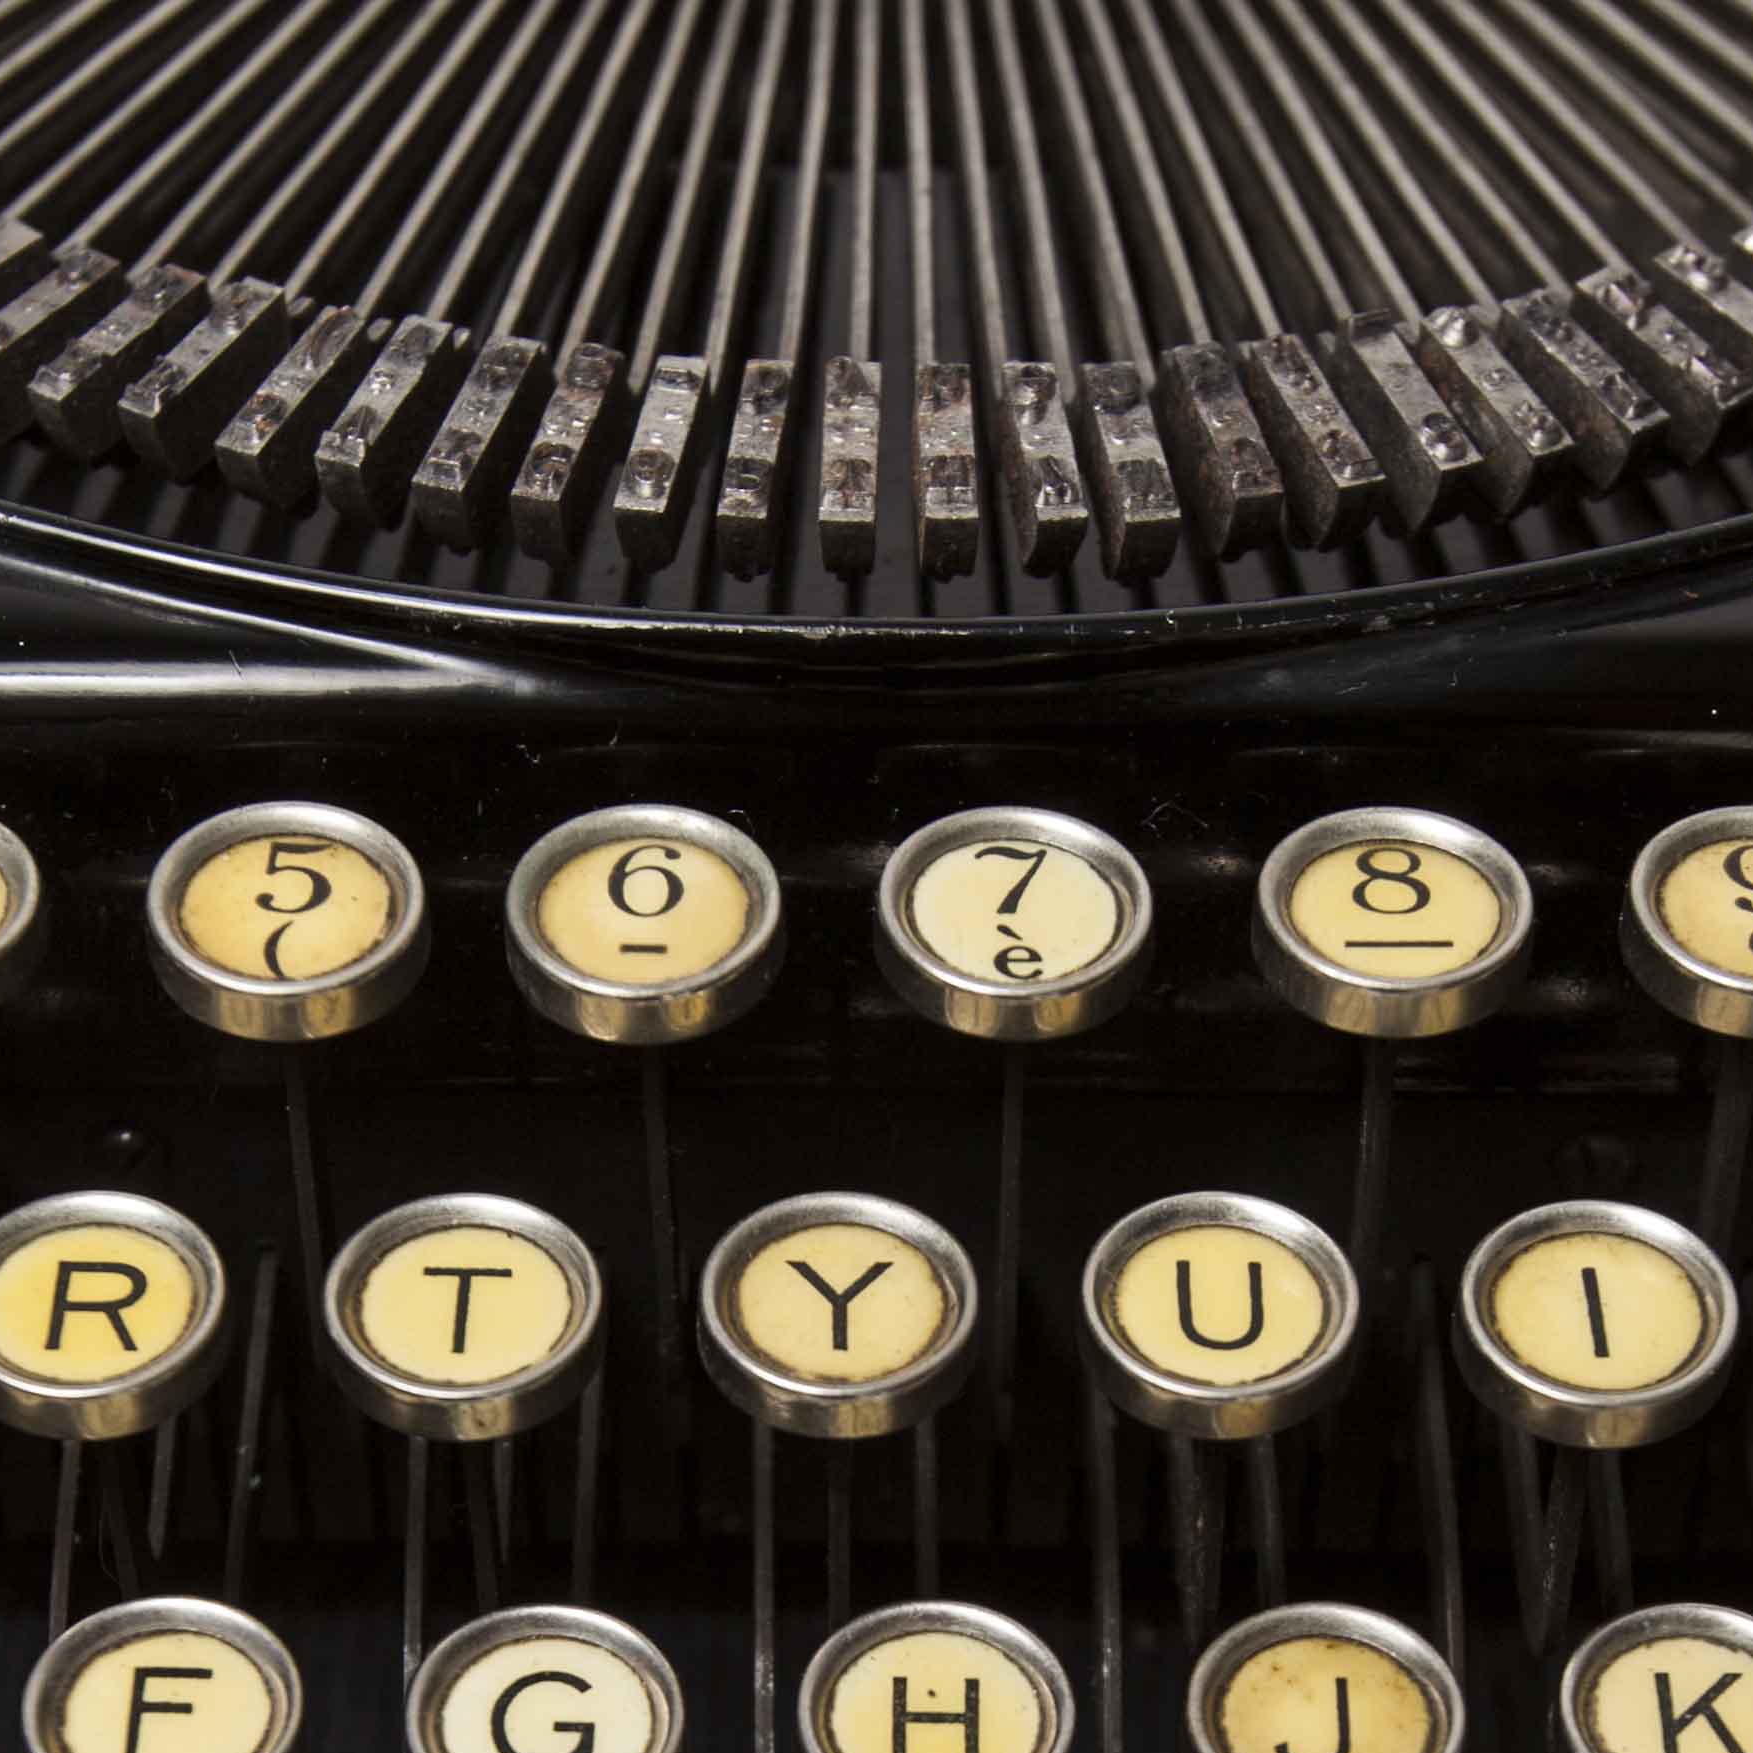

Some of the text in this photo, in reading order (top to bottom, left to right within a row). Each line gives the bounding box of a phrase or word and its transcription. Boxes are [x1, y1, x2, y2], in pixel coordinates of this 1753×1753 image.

[255, 843, 333, 915] 5
[607, 844, 685, 918] 6
[973, 849, 1048, 915] 7
[1351, 851, 1432, 915] 8
[263, 919, 292, 980] (
[992, 923, 1044, 978] è
[43, 1259, 149, 1353] R
[422, 1266, 514, 1355] T
[785, 1259, 895, 1352] Y
[1175, 1259, 1265, 1352] U
[1580, 1266, 1611, 1359] I
